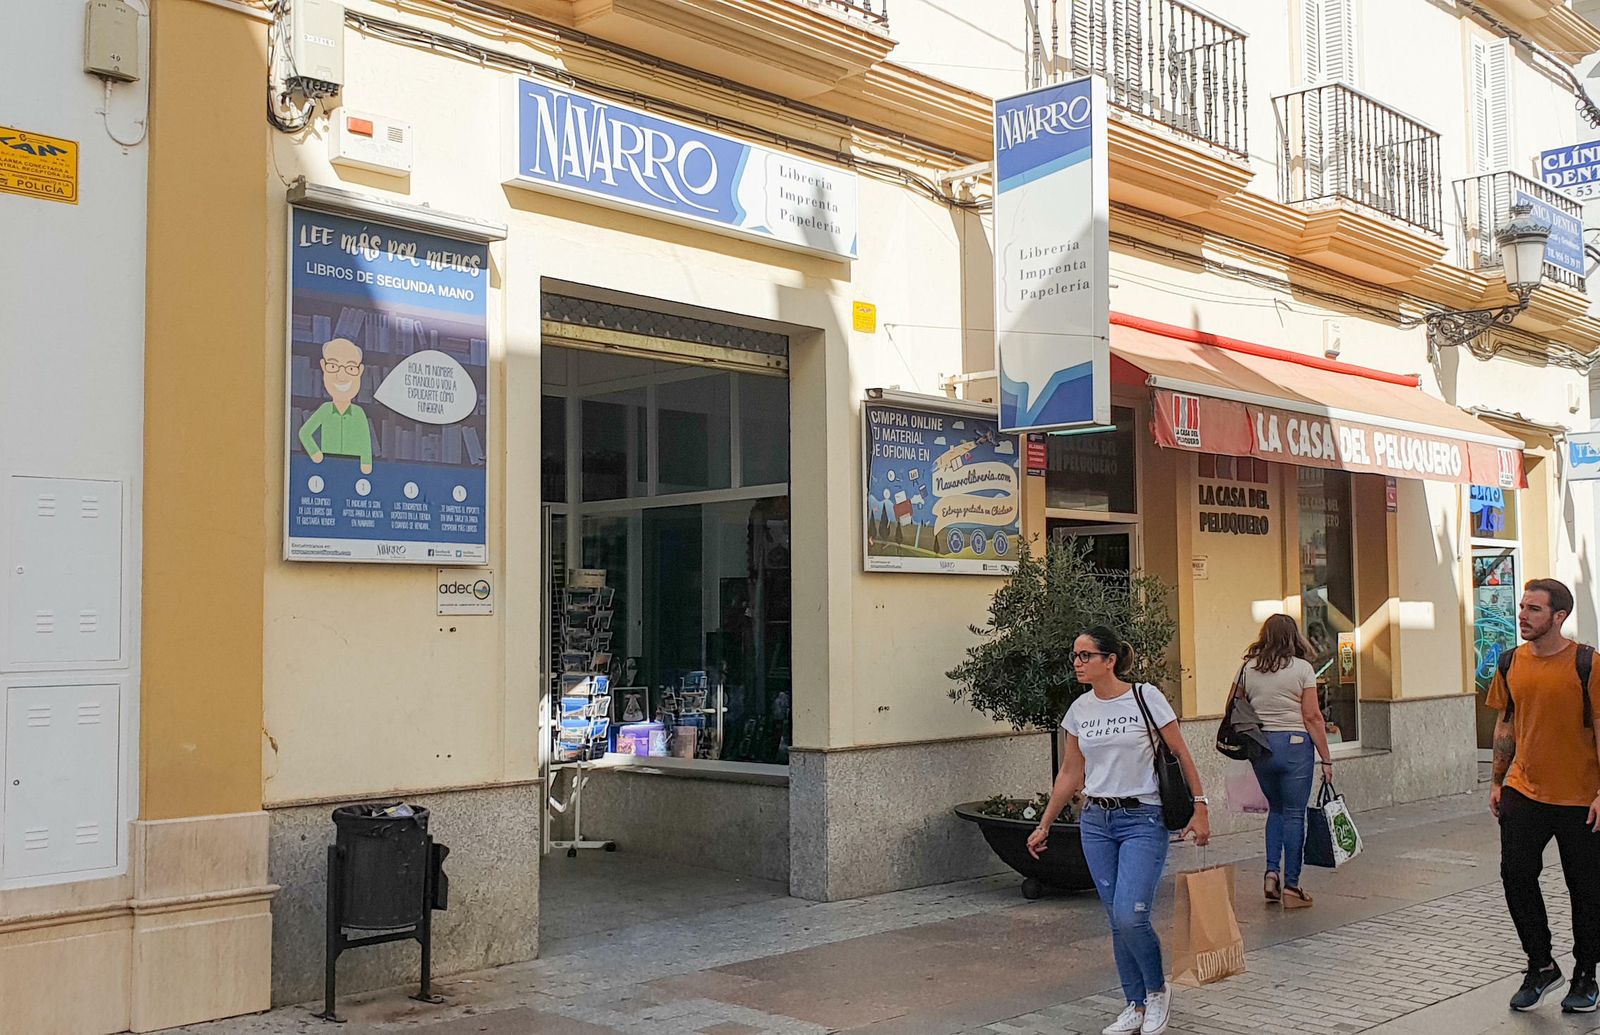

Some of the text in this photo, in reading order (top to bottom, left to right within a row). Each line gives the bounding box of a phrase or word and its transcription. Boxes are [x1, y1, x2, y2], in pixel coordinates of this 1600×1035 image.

[998, 95, 1092, 151] NAVARRO
[528, 90, 720, 213] NAVARRO
[17, 179, 65, 194] POLICÍA
[779, 164, 833, 190] Librería
[779, 186, 839, 213] Imprenta
[780, 208, 842, 235] Papelería
[300, 223, 335, 248] LEE
[1020, 240, 1080, 260] Librería
[1020, 260, 1087, 281] Imprenta
[306, 262, 475, 301] LIBROS DE SEGUNDA MANO
[405, 374, 411, 386] ES
[412, 376, 435, 389] MANOLO
[432, 366, 454, 379] NOMBRE
[911, 415, 943, 431] ONLINE
[1180, 429, 1190, 437] CASA
[1191, 430, 1199, 438] DEL
[882, 428, 925, 445] MATERIAL
[1256, 413, 1462, 477] LA CASA DEL PELUQUERO
[883, 444, 917, 460] OFICINA
[919, 448, 930, 462] EN
[1199, 485, 1270, 510] LA CASA DEL
[1199, 512, 1269, 535] PELUQUERO
[1081, 715, 1138, 729] OUI MON
[1086, 726, 1126, 738] CHÉRI
